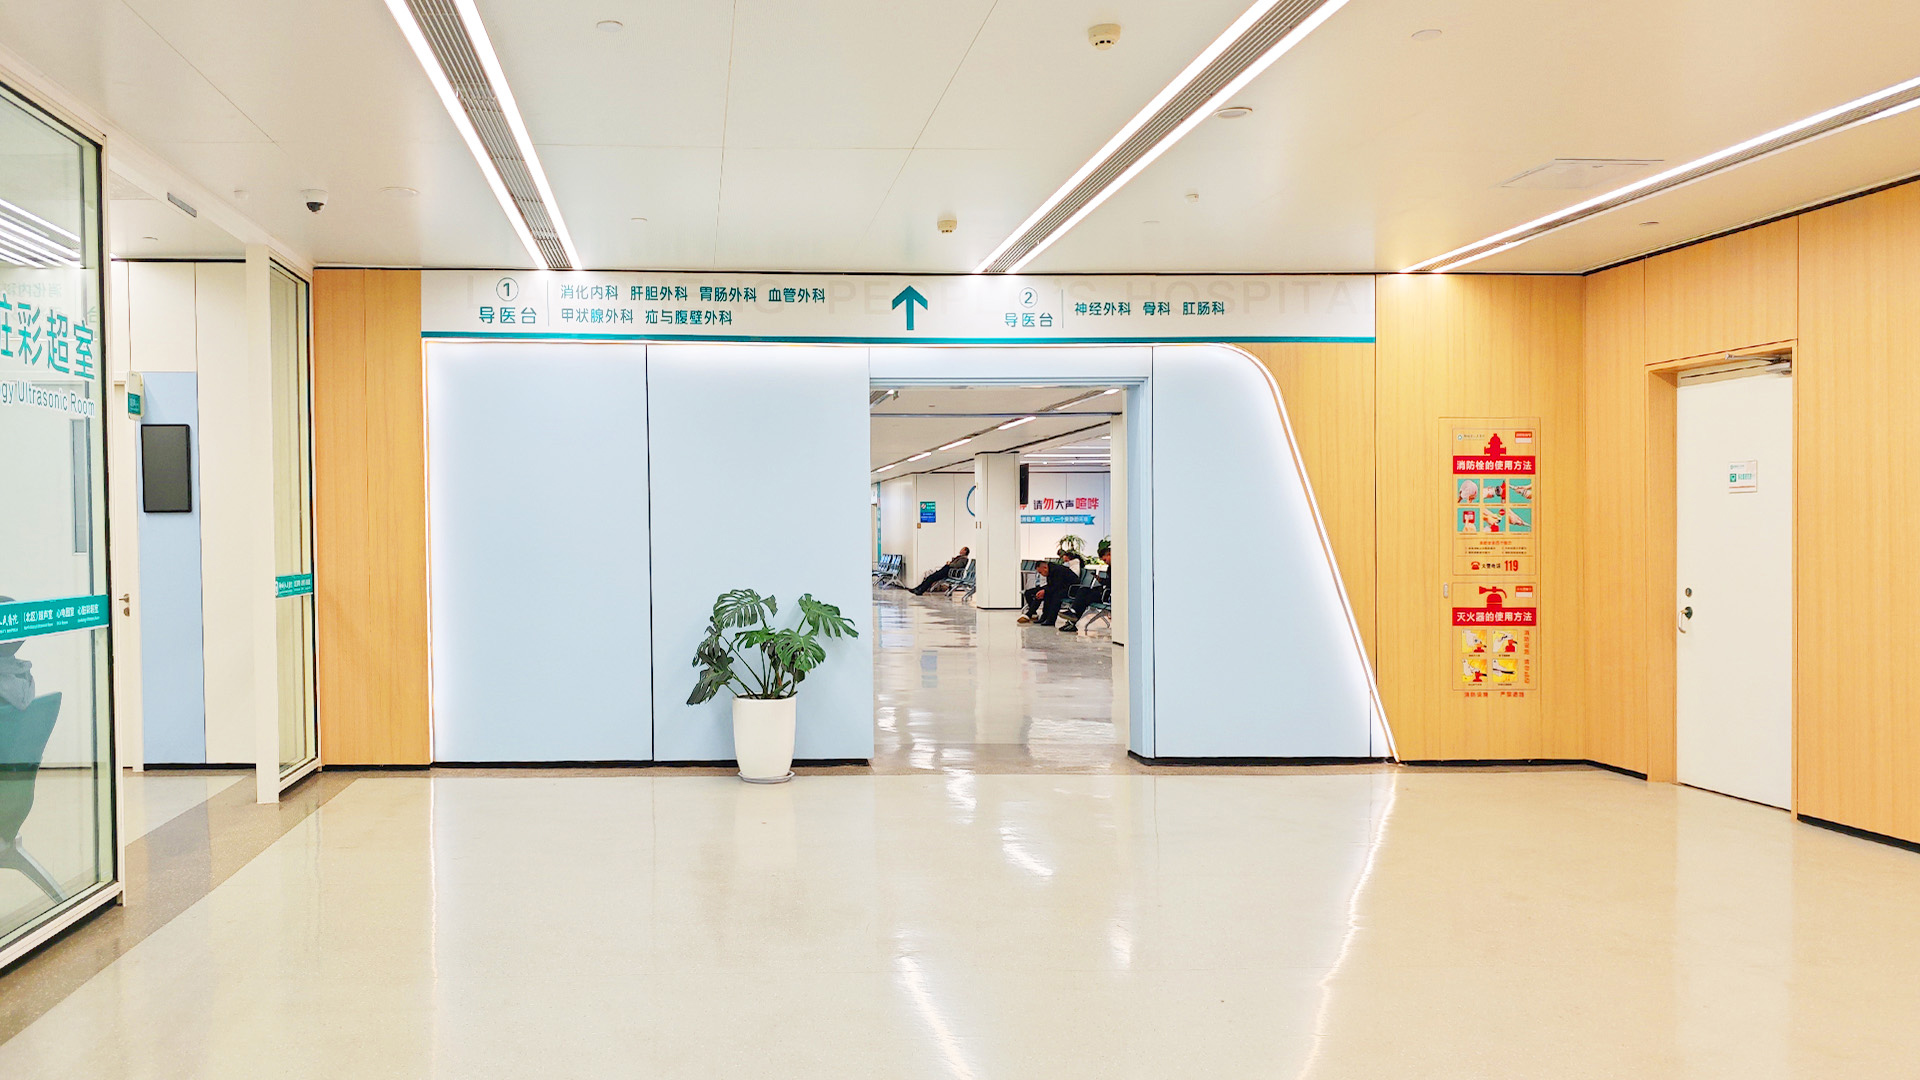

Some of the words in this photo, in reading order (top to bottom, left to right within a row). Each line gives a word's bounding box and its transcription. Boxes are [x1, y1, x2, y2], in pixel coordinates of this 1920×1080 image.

[560, 284, 618, 300] 消化内科
[630, 285, 688, 301] 肝胆外科
[699, 286, 757, 302] 胃肠外科
[768, 287, 826, 303] 血管外科
[478, 306, 537, 325] 导医台
[1074, 301, 1131, 316] 神经外科
[1142, 301, 1171, 316] 骨科
[1182, 301, 1225, 316] 肛肠科
[561, 308, 634, 324] 甲状腺外科
[645, 309, 733, 326] 疝与腹壁外科
[1004, 312, 1053, 328] 导医台
[17, 380, 68, 411] Ultrasonic
[70, 391, 95, 417] Room
[1456, 460, 1533, 471] 消防栓的使用方法
[1033, 497, 1100, 511] 请勿大声喧哗
[1504, 559, 1519, 572] 119
[1456, 611, 1533, 622] 灭火器的使用方法
